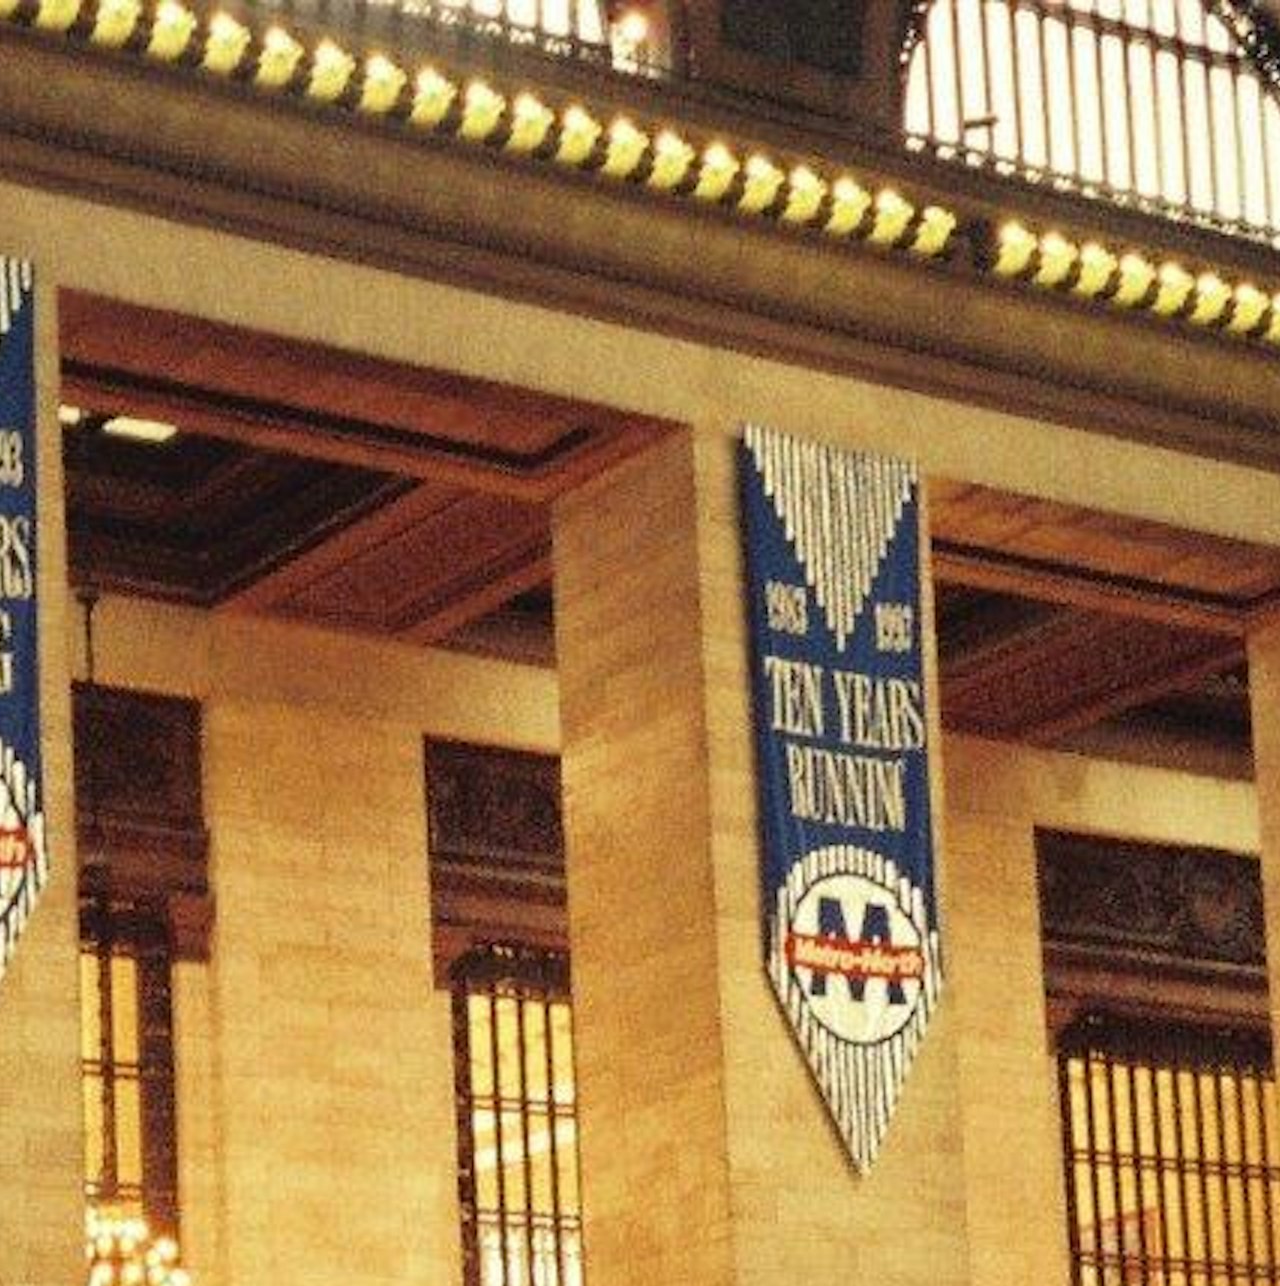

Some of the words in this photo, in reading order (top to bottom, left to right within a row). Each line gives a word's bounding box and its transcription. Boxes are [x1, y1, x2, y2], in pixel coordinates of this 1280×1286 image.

[764, 655, 824, 736] TEN
[833, 669, 927, 752] YEARS
[786, 743, 907, 831] RUNNING
